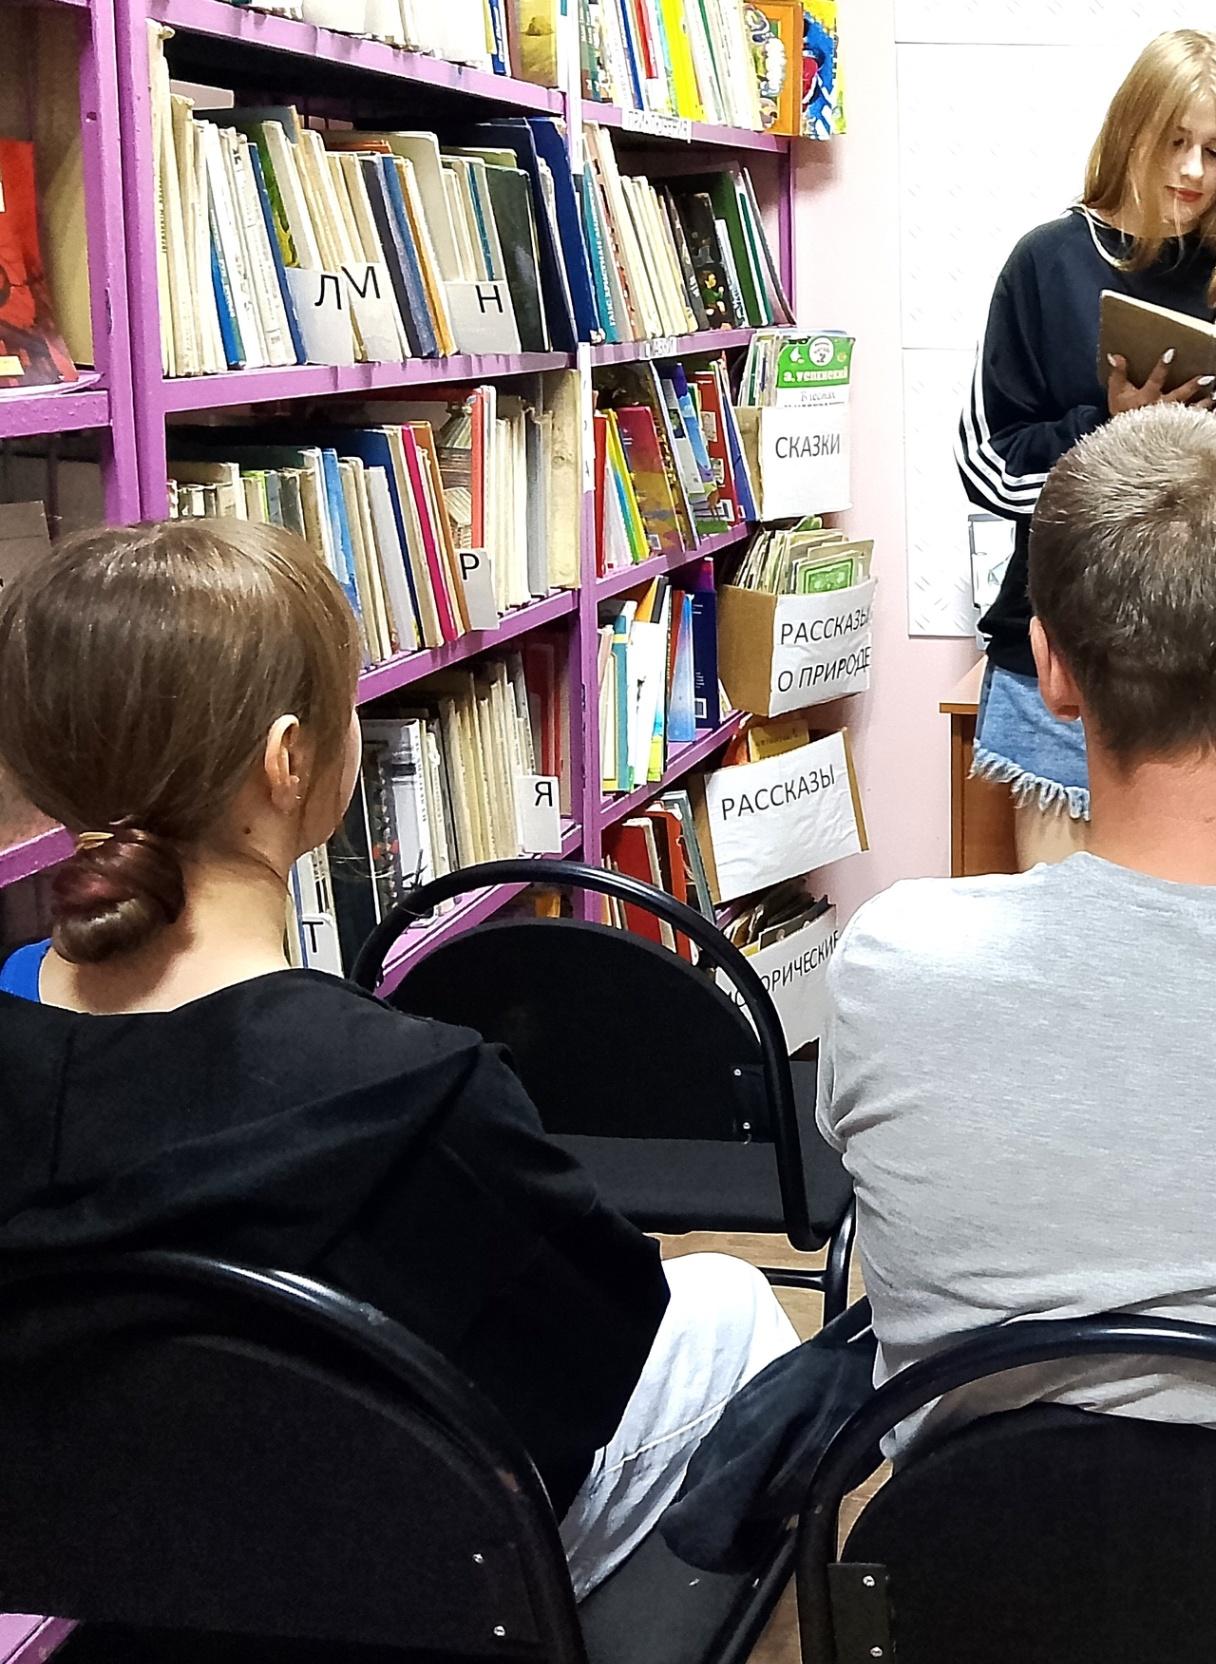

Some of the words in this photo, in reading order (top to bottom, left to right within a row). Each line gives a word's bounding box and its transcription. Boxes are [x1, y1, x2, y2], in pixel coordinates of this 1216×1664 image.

[314, 275, 343, 310] Л
[341, 265, 381, 299] М
[475, 284, 503, 313] Н
[775, 433, 841, 459] СКАЗКИ
[459, 553, 481, 580] Р
[780, 606, 871, 646] РАССКАЗЫ
[777, 670, 794, 693] О
[798, 647, 872, 688] ПРИРОДЕ
[534, 781, 554, 807] Я
[721, 764, 836, 821] РАССКАЗЫ
[301, 920, 325, 953] Т
